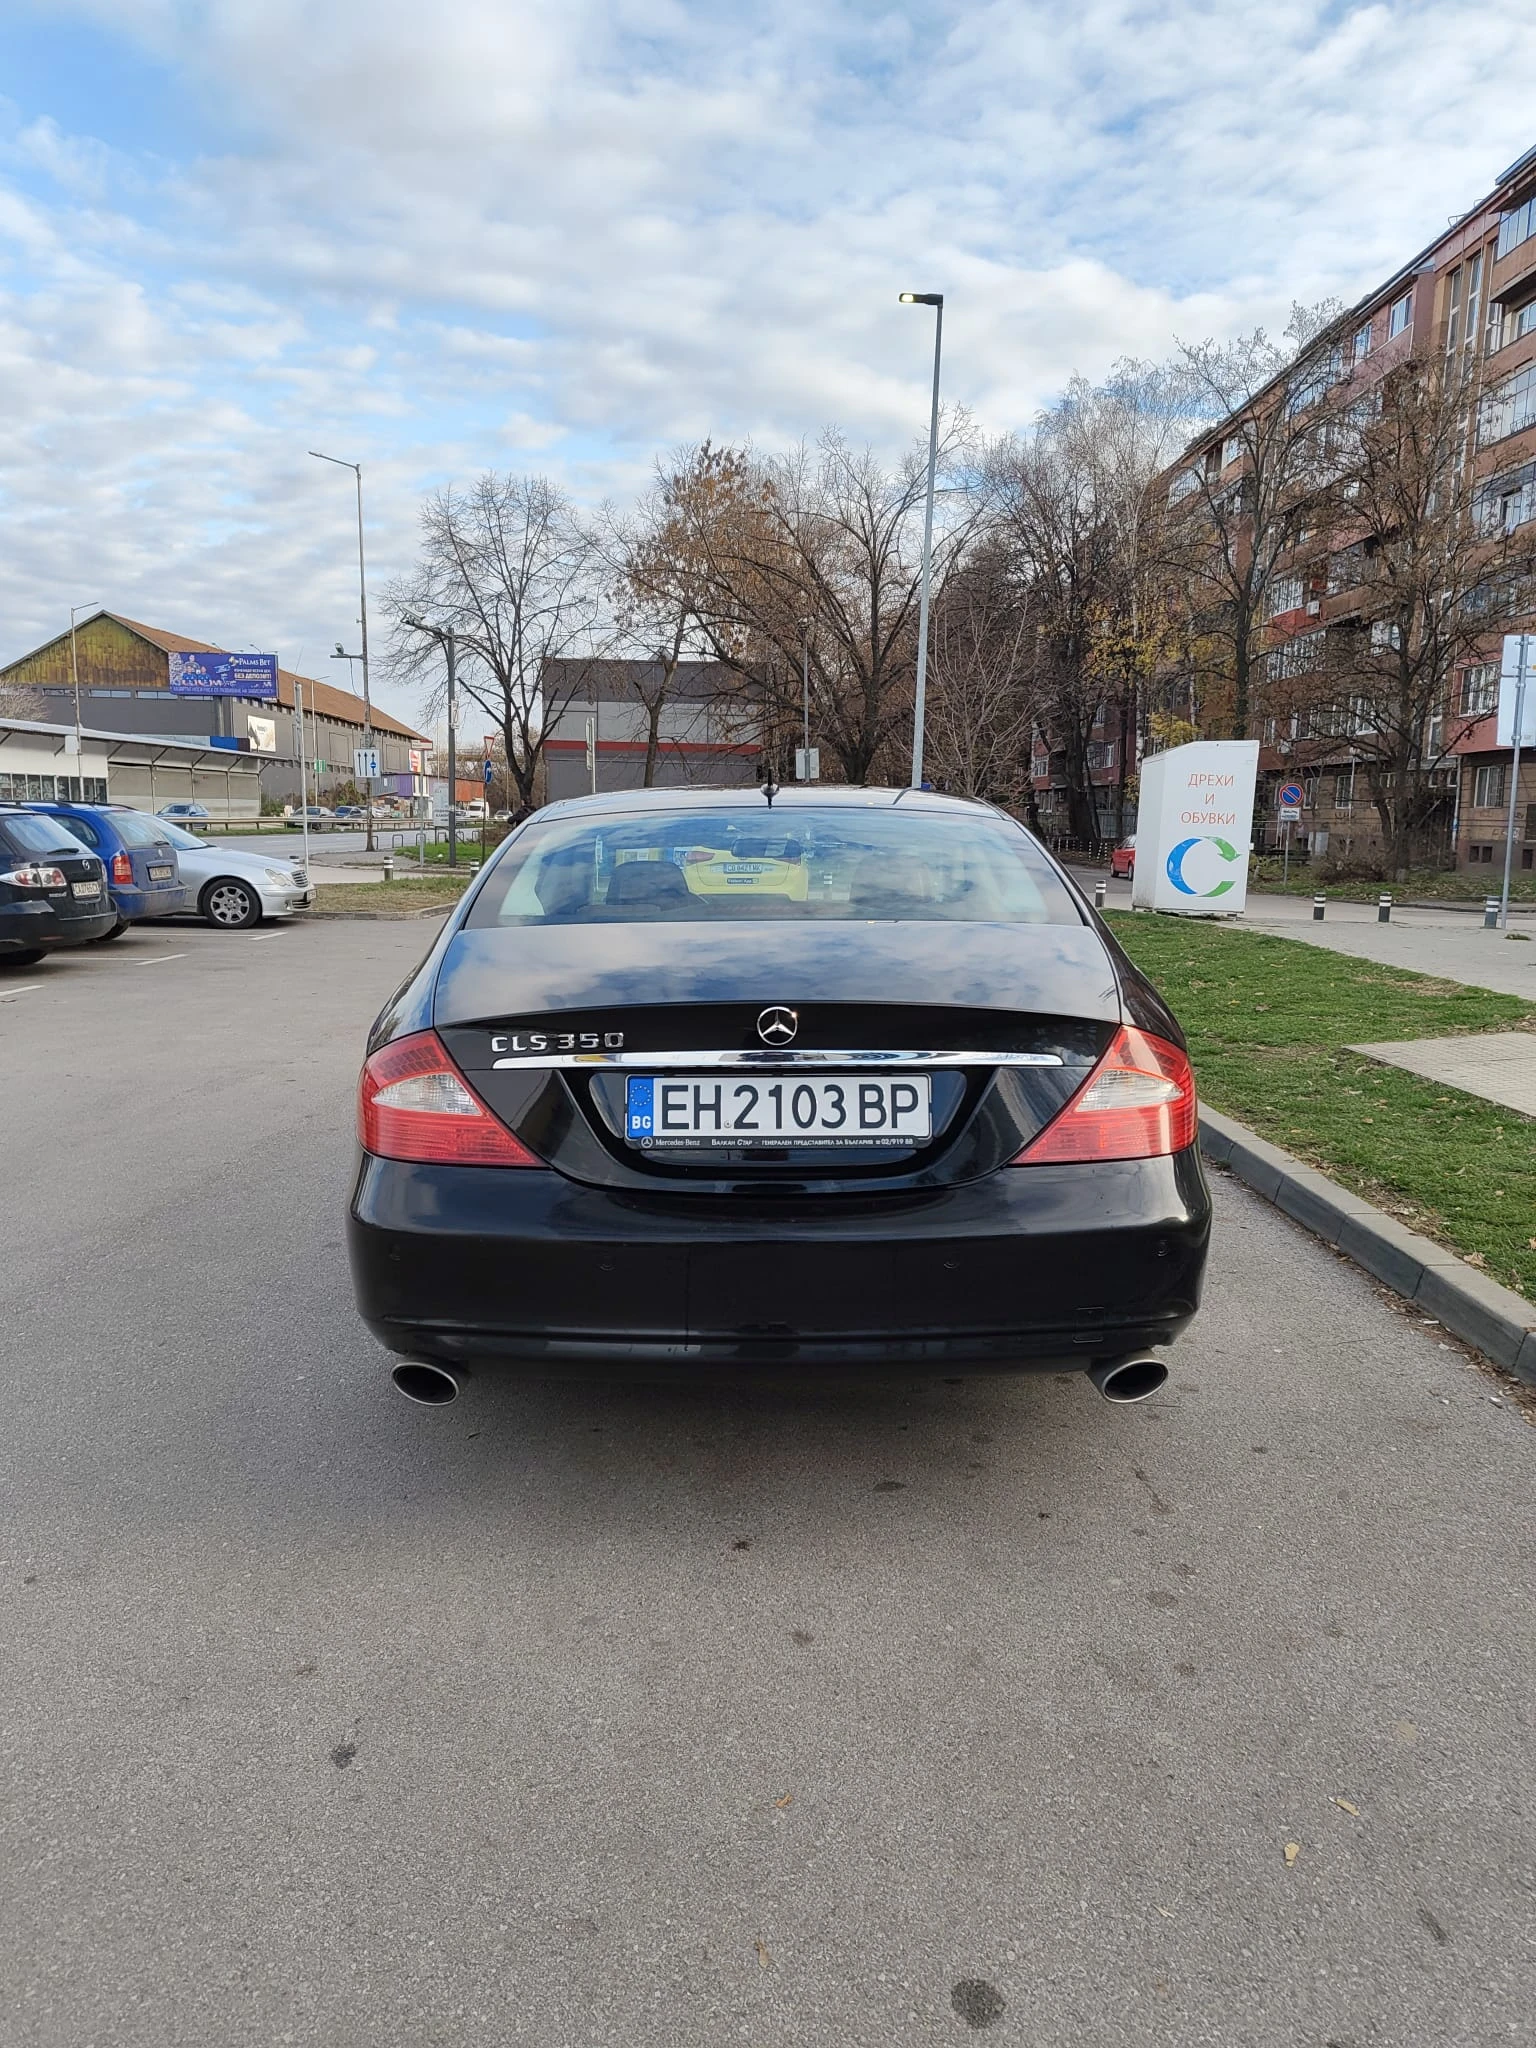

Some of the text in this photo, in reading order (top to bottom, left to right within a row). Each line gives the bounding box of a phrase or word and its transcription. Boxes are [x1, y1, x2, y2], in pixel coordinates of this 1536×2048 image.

[1188, 774, 1234, 788] ДРЕХИ
[1205, 793, 1215, 805] И
[1181, 811, 1235, 825] ОБУВКИ
[491, 1032, 624, 1052] CLS 350
[631, 1115, 652, 1130] BG
[655, 1138, 701, 1146] Mercedes-Benz
